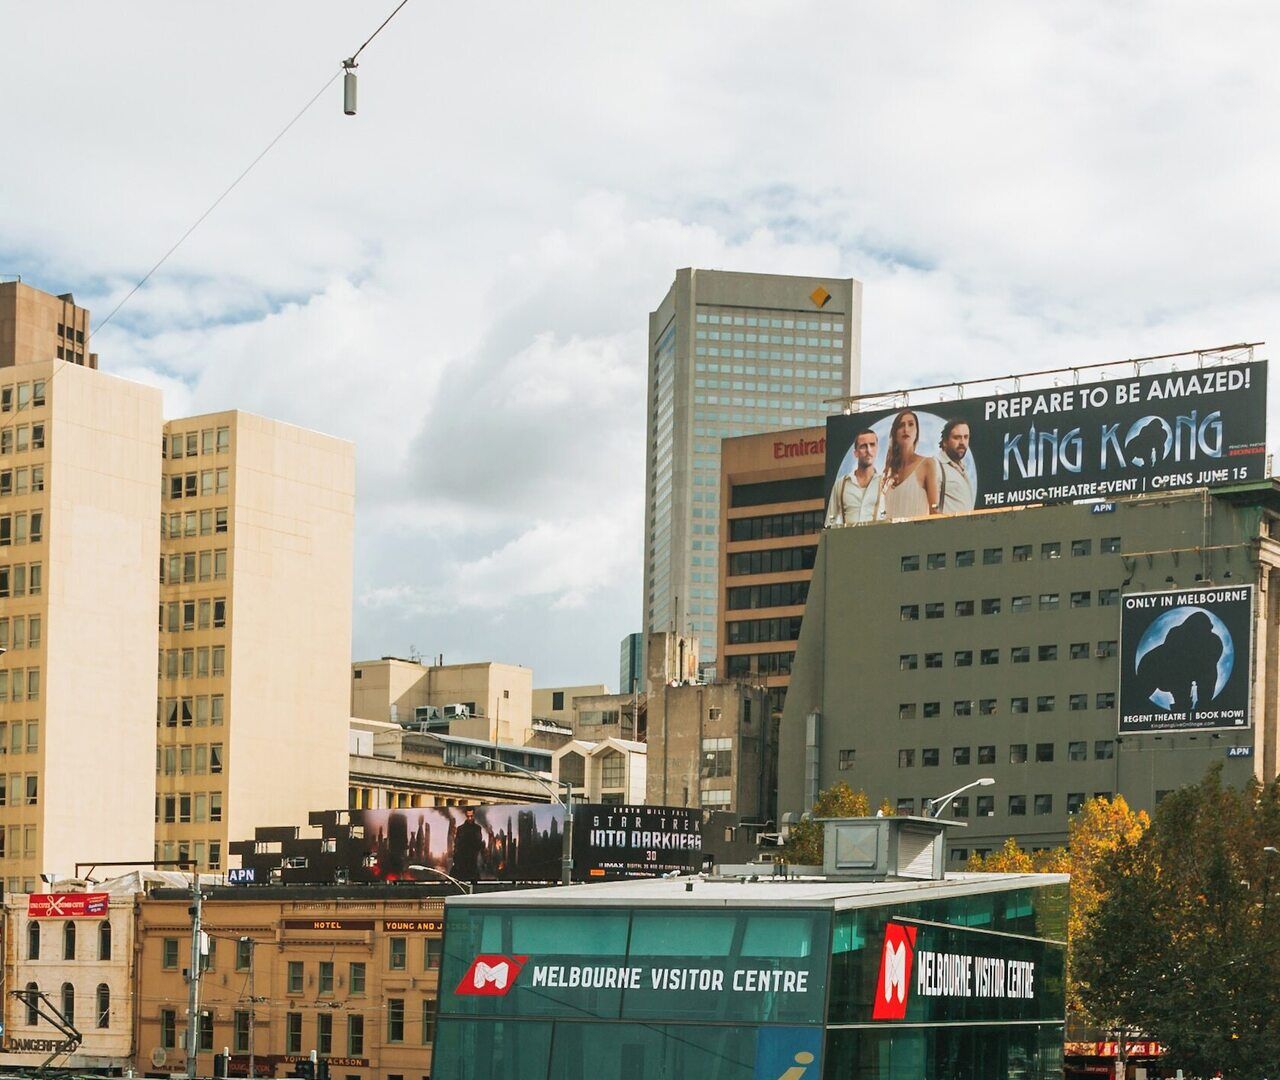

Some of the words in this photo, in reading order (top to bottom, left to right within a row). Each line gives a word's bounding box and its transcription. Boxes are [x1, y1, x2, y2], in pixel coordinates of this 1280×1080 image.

[984, 391, 1074, 421] PREPARE
[1080, 388, 1108, 408] TO
[1116, 382, 1140, 405] BE
[1147, 367, 1251, 400] AMAZED!
[1002, 420, 1083, 481] KING
[1100, 409, 1224, 470] KONG
[1151, 470, 1193, 489] OPENS
[1196, 469, 1229, 484] JUNE
[1232, 466, 1248, 480] 15
[984, 493, 1004, 505] THE
[1007, 488, 1044, 504] MUSIC
[1047, 483, 1097, 499] THEATRE
[1100, 478, 1138, 495] EVENT
[1093, 502, 1113, 514] APN
[1126, 597, 1157, 610] ONLY
[1160, 596, 1173, 607] IN
[1176, 590, 1248, 606] MELBOURNE
[1123, 714, 1153, 724] REGENT
[1154, 712, 1186, 722] THEATRE
[1195, 710, 1219, 720] BOOK
[1220, 709, 1244, 719] NOW!
[1229, 747, 1250, 756] APN
[593, 815, 642, 829] STAR
[661, 817, 700, 832] TREK
[590, 829, 626, 848] INTO
[631, 830, 701, 850] DARKNESS
[229, 869, 255, 881] APN
[313, 921, 342, 929] HOTEL
[386, 922, 415, 930] YOUNG
[417, 922, 435, 930] AND
[531, 966, 643, 990] MELBOURNE
[651, 968, 724, 991] VISITOR
[732, 970, 810, 993] CENTRE
[917, 950, 972, 997] MELBOURNE
[974, 956, 1005, 998] VISITOR
[1007, 960, 1035, 999] CENTRE
[324, 1058, 362, 1067] ACKSON
